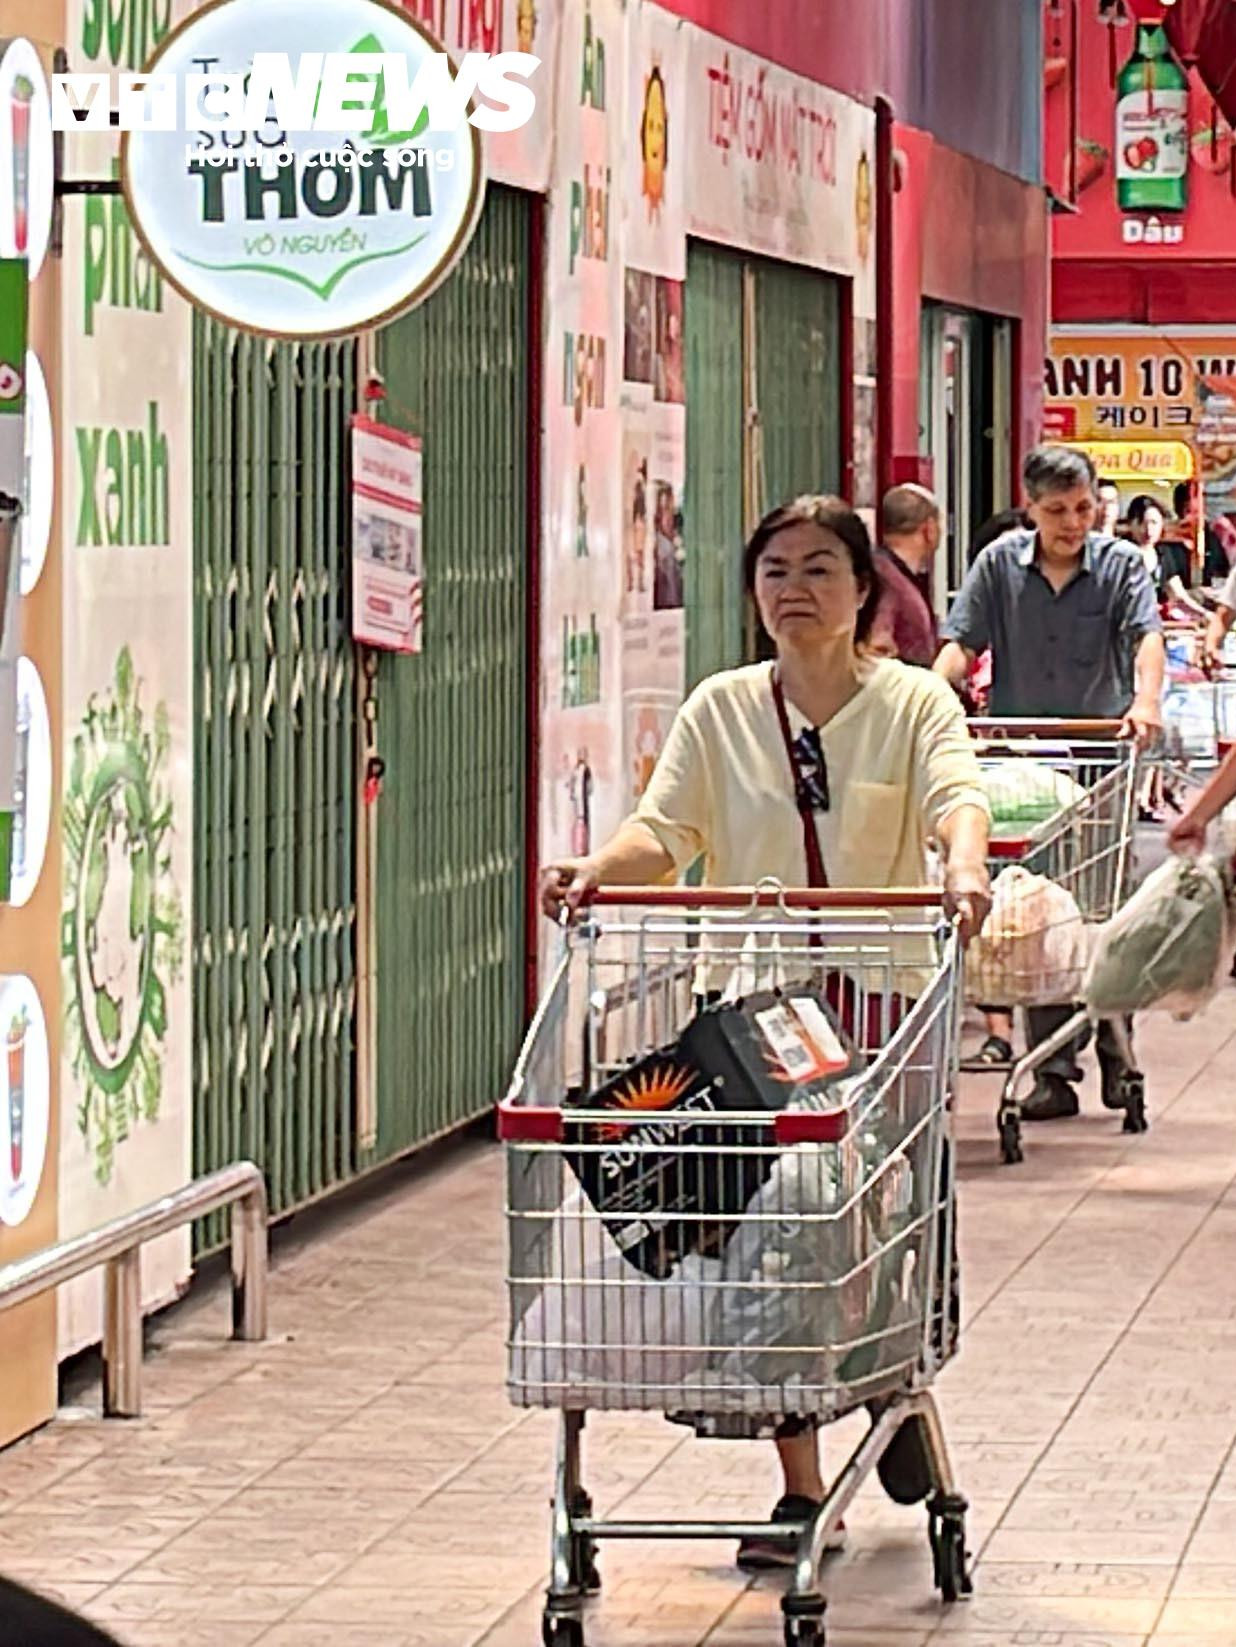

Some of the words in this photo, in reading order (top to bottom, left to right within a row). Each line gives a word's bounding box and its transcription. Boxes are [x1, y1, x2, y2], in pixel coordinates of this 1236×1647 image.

[1122, 216, 1184, 244] Dâu
[1096, 406, 1193, 428] 케이크
[76, 401, 171, 547] xanh
